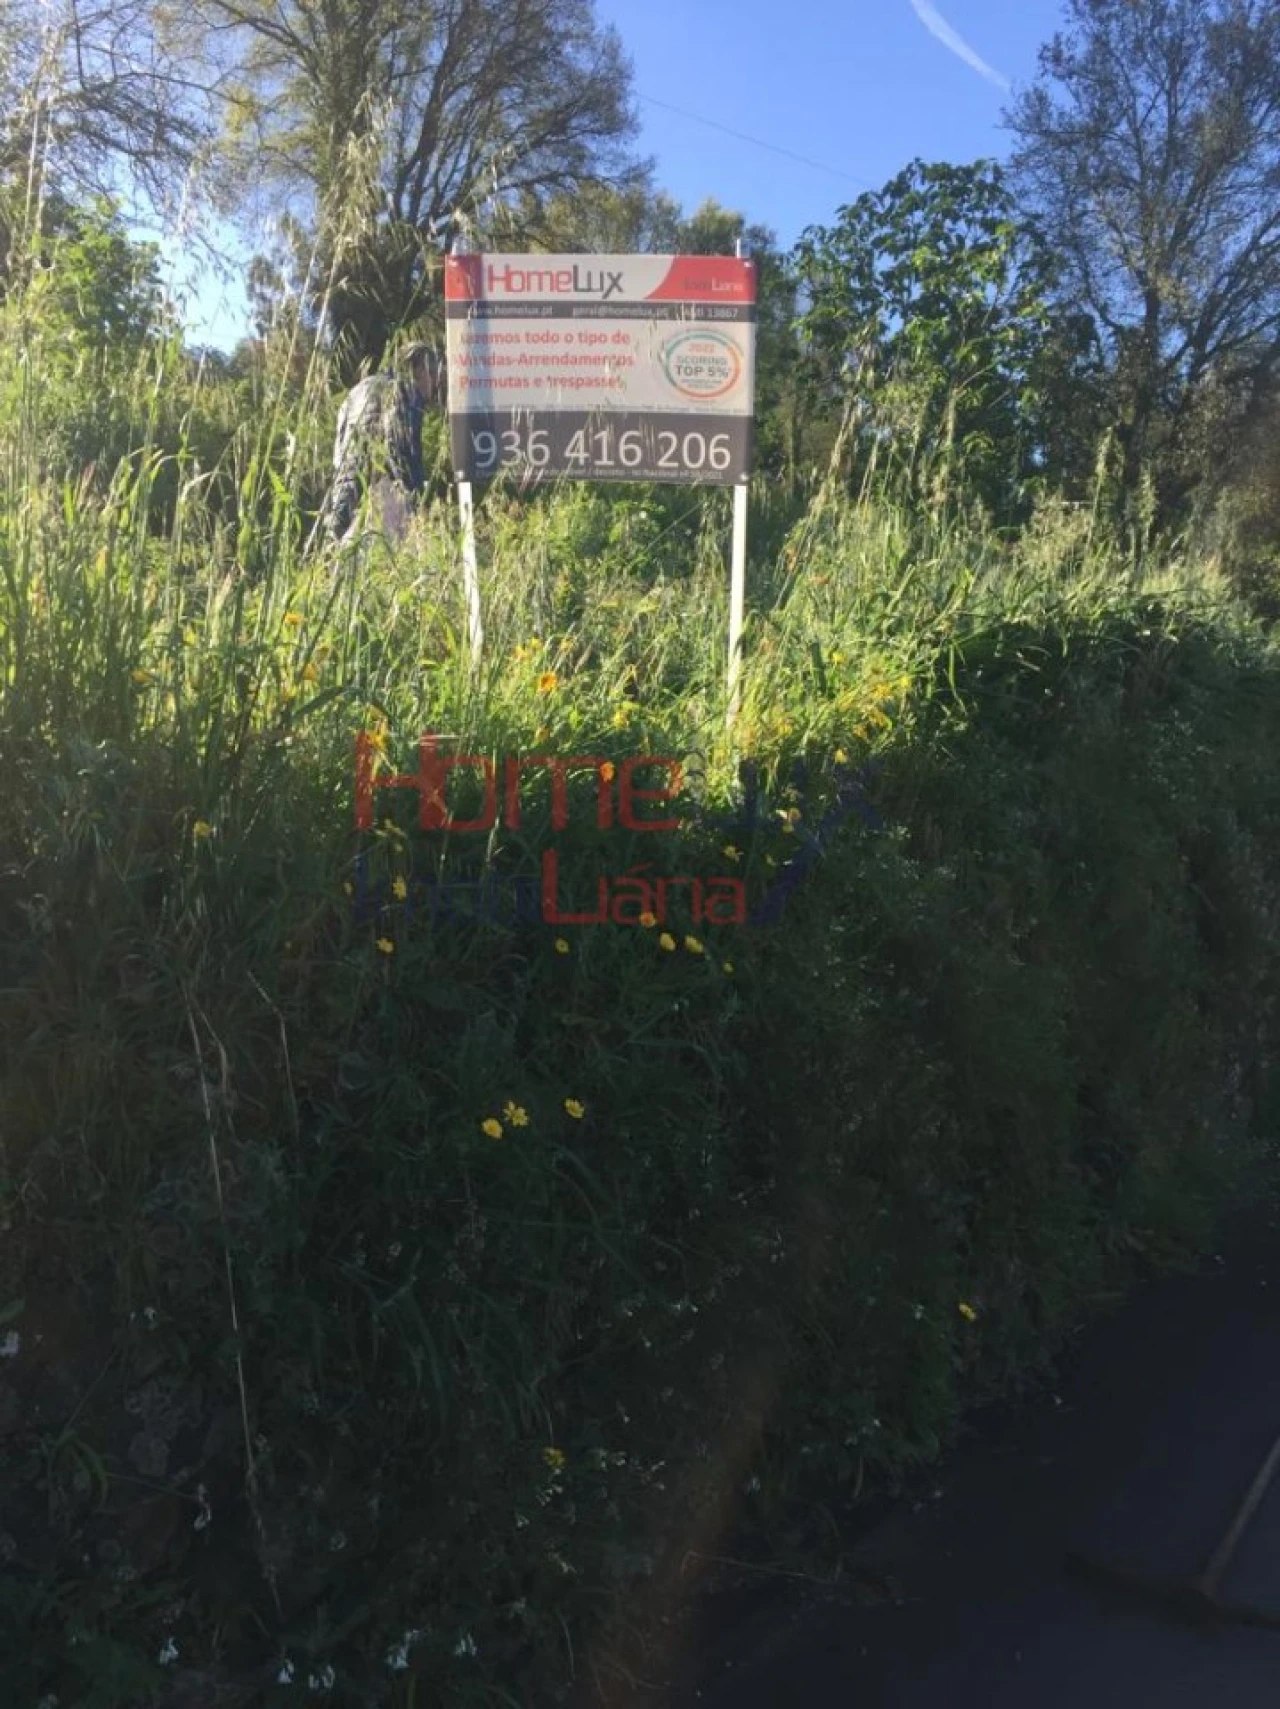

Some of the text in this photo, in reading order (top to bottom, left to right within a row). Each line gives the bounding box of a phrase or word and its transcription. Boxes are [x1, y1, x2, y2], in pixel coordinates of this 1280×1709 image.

[487, 264, 624, 299] HomeLux
[525, 329, 560, 344] todo
[564, 333, 574, 344] o
[578, 330, 608, 347] tipo
[611, 329, 632, 344] de
[676, 365, 729, 377] TOP 5%
[459, 375, 529, 389] Permutas
[534, 377, 543, 388] e
[474, 430, 732, 469] 936 416 206
